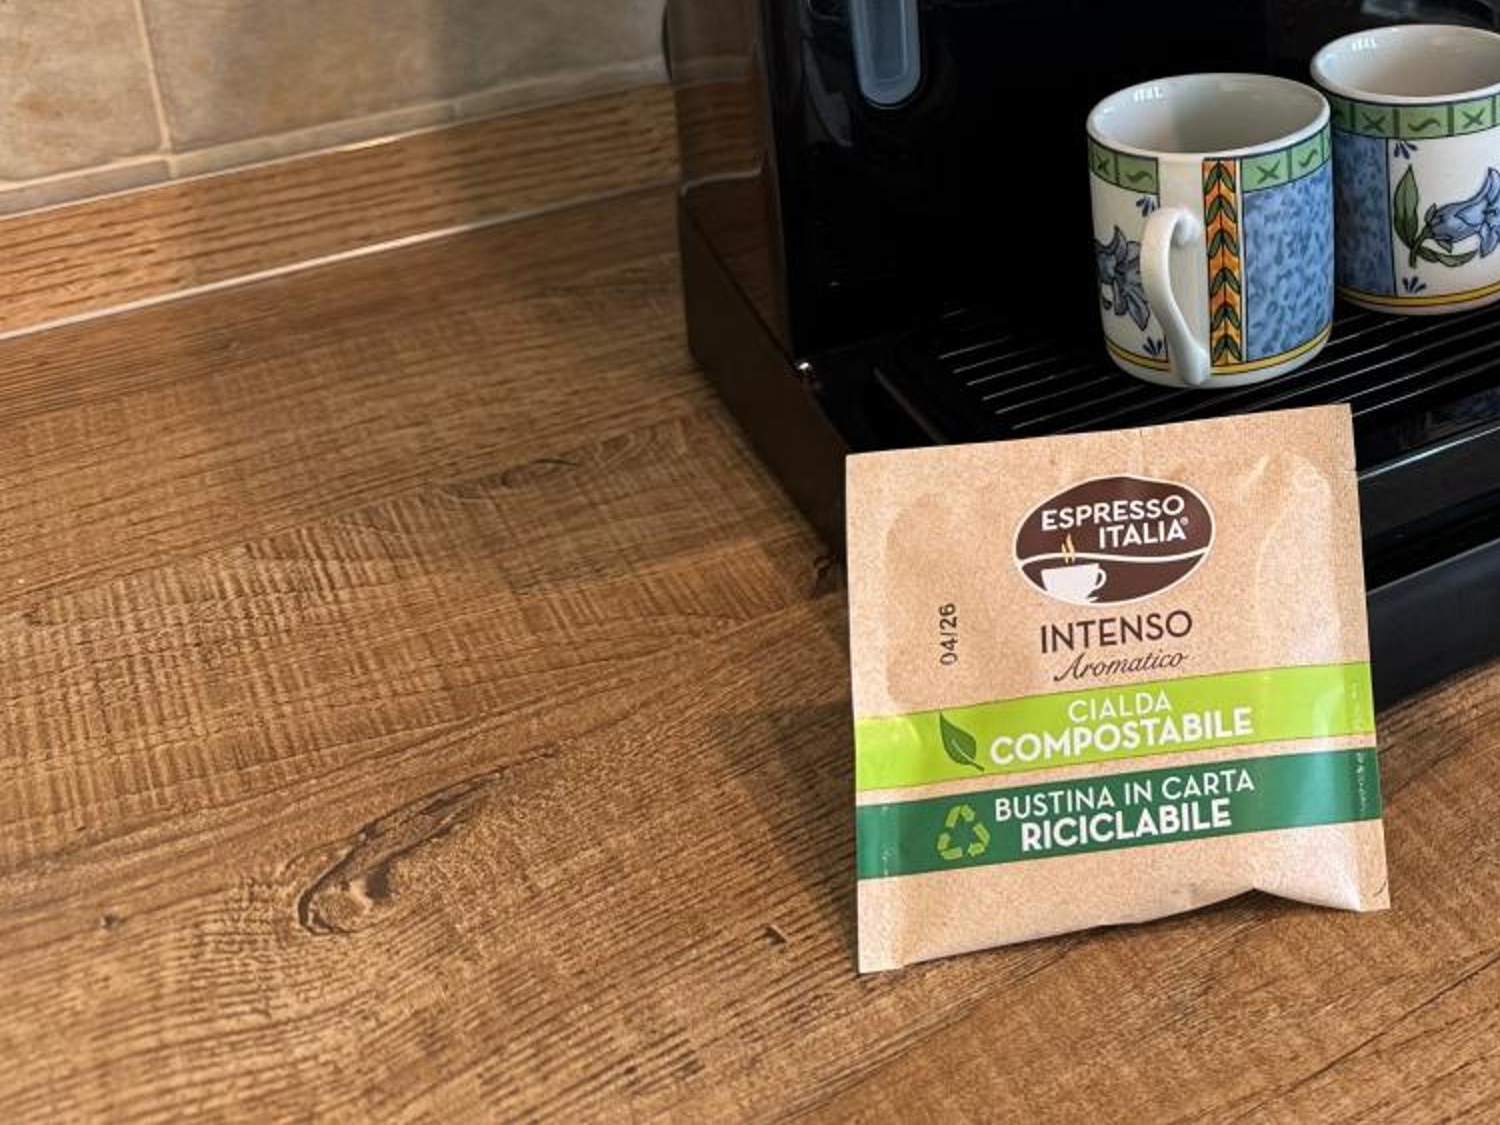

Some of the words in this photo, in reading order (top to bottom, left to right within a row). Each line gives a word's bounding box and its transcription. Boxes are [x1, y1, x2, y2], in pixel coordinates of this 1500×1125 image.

[1041, 494, 1186, 532] ESPRESSO
[939, 602, 958, 666] 04/26
[1040, 609, 1193, 654] INTENSO
[1053, 649, 1188, 682] Aromatico
[1068, 691, 1172, 722] CIALDA
[990, 707, 1255, 765] COMPOSTABILE
[995, 791, 1115, 821] BUSTINA
[1125, 778, 1152, 803] IN
[1162, 768, 1255, 799] CARTA
[1021, 797, 1232, 852] RICICLABILE
